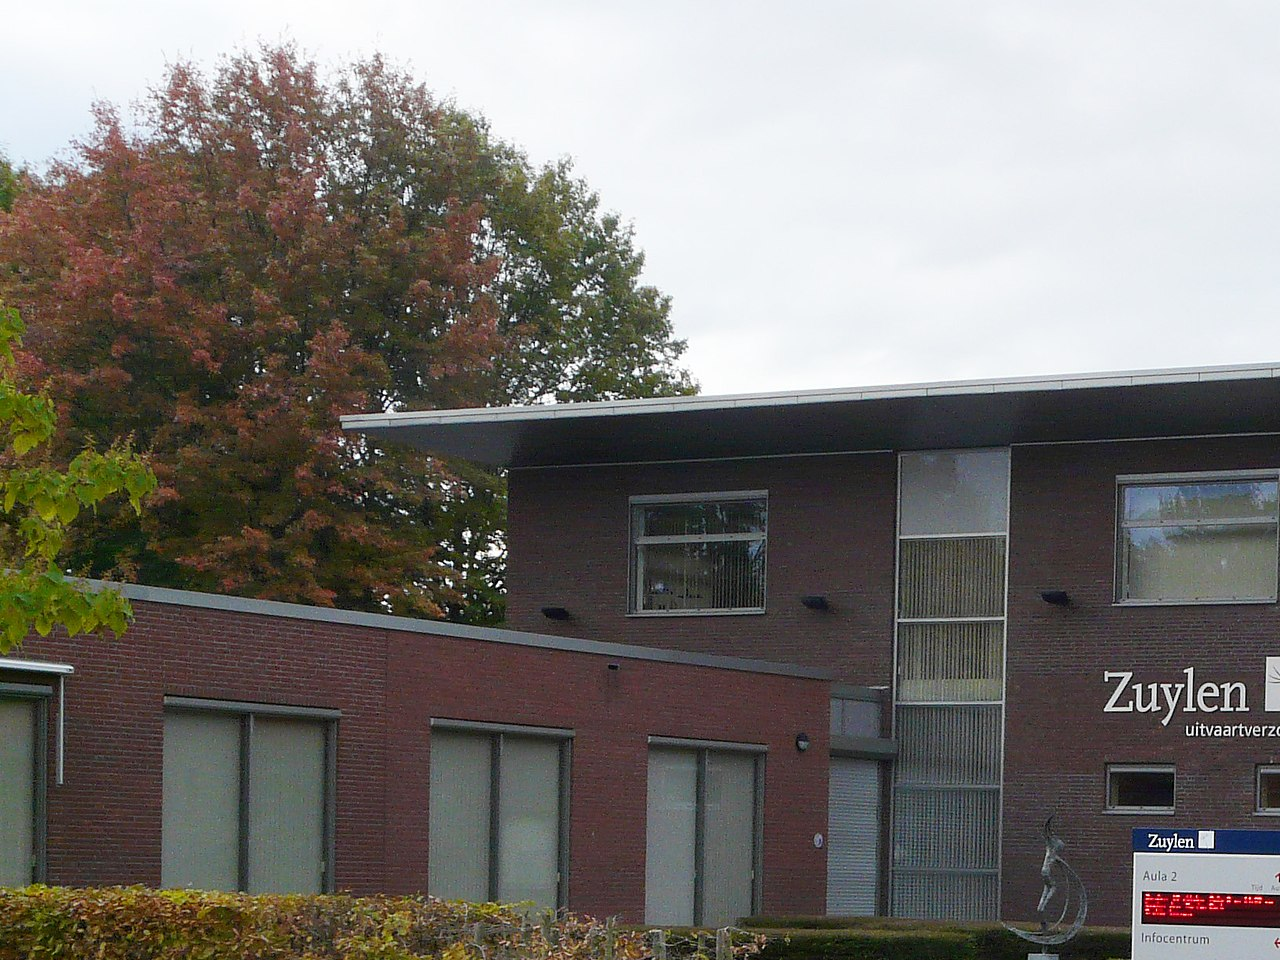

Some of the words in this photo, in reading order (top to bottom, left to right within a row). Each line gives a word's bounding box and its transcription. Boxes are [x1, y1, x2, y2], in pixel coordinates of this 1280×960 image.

[1103, 666, 1250, 727] Zuylen
[1148, 834, 1194, 851] Zuylen
[1143, 870, 1168, 882] Aula
[1171, 871, 1178, 882] 2
[1141, 932, 1210, 945] Infocentrum
